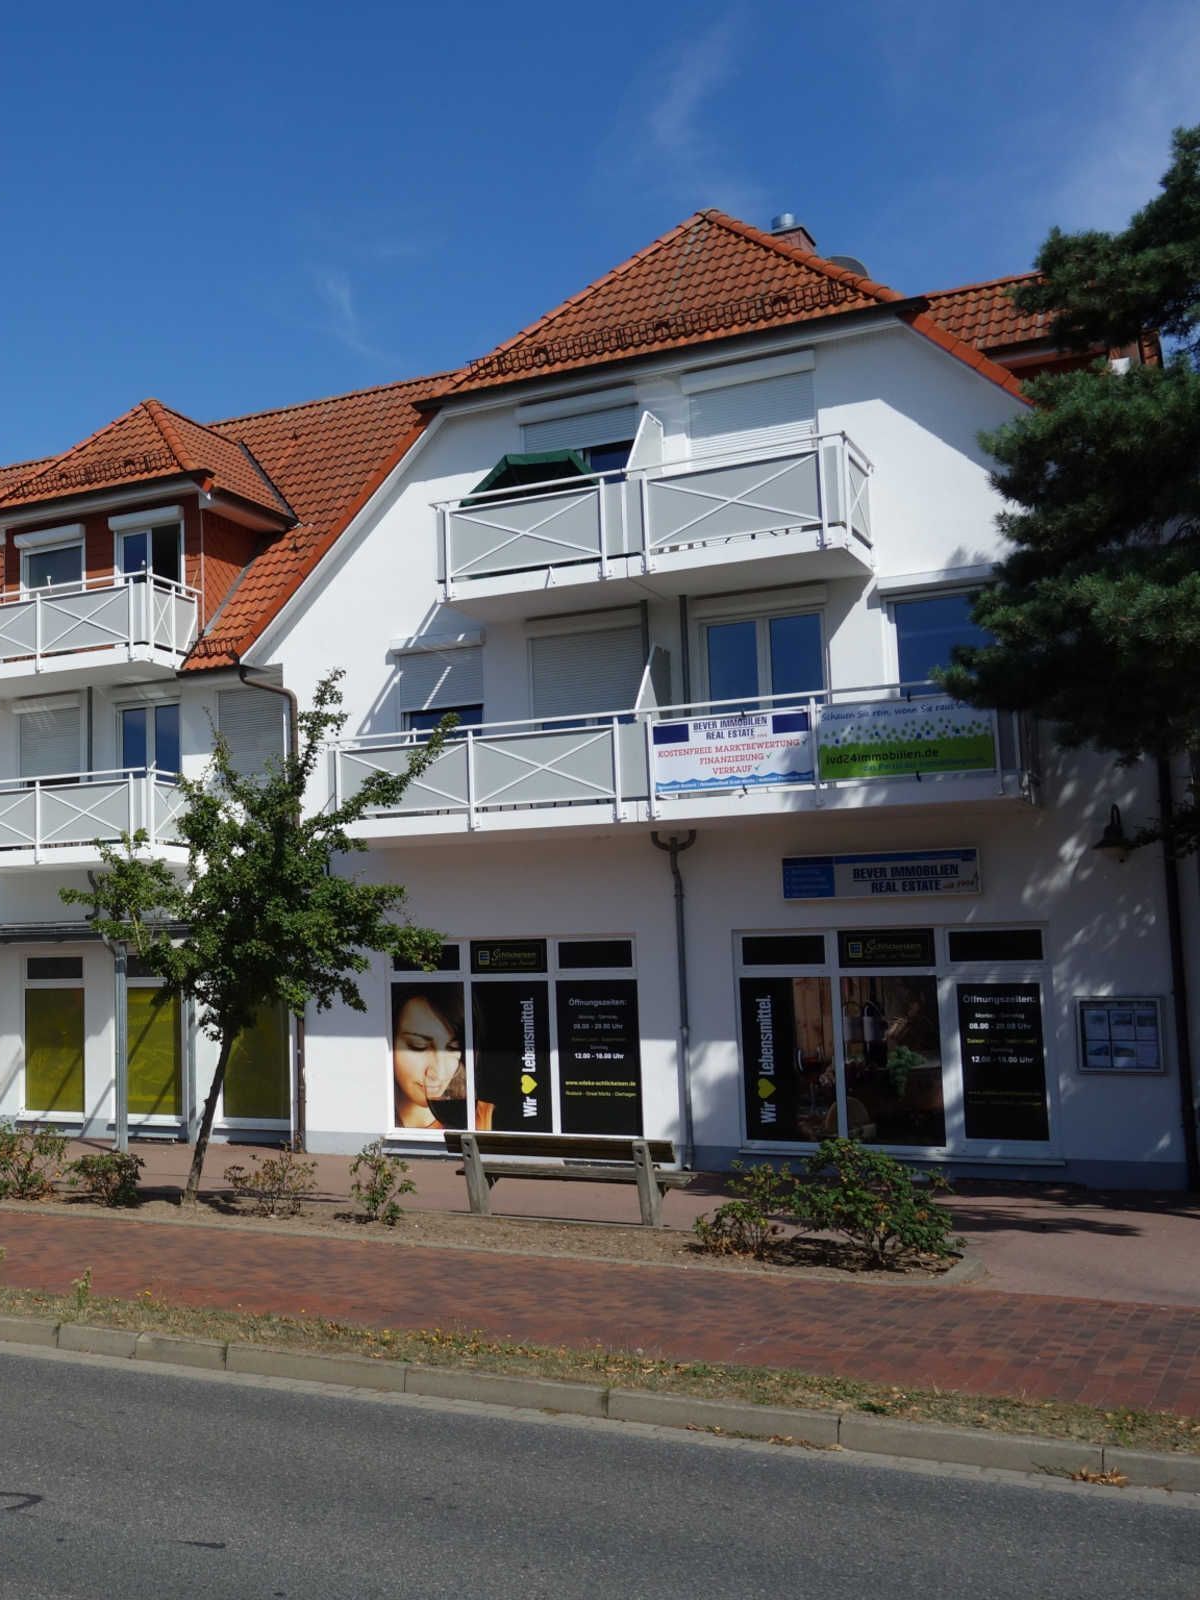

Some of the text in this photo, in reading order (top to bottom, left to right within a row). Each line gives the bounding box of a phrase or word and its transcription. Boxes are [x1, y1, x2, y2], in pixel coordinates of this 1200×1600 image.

[693, 715, 768, 730] BEVER IMMOBILIEN
[706, 730, 725, 740] REAL
[728, 728, 755, 739] ESTATE
[657, 738, 801, 758] KOSTENFREIE MARKTBEWERTUNG
[700, 752, 765, 765] FINANZIERUNG
[712, 765, 753, 775] VERKAUF
[853, 864, 959, 879] BEVER IMMOBILIEN
[872, 880, 898, 893] REAL
[902, 879, 941, 892] ESTATE
[520, 998, 537, 1117] Wir Lebensmittel.
[613, 1052, 625, 1060] Uhr
[755, 995, 777, 1123] Wir Lebensmittel.
